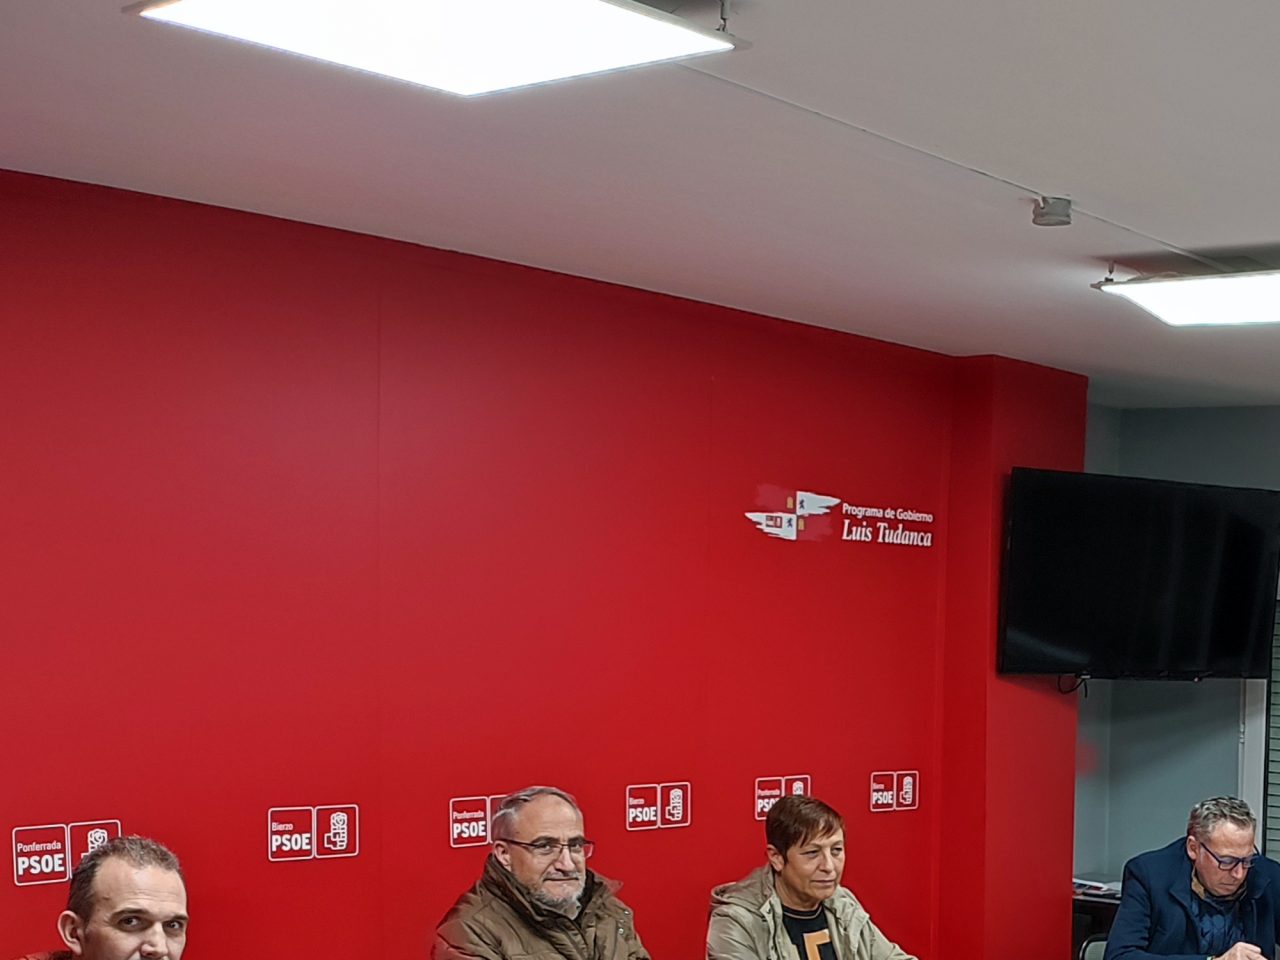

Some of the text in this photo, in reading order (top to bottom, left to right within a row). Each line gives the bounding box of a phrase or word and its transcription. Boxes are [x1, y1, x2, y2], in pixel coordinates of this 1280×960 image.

[842, 502, 934, 523] Programa de Gobierno
[842, 519, 933, 547] Luis Tudanca
[872, 791, 894, 805] PSOE
[628, 806, 657, 823] PSOE
[271, 822, 294, 831] Bierzo
[453, 821, 487, 839] PSOE
[17, 840, 62, 852] Ponferrada
[271, 833, 311, 852] PSOE
[17, 853, 65, 876] PSOE
